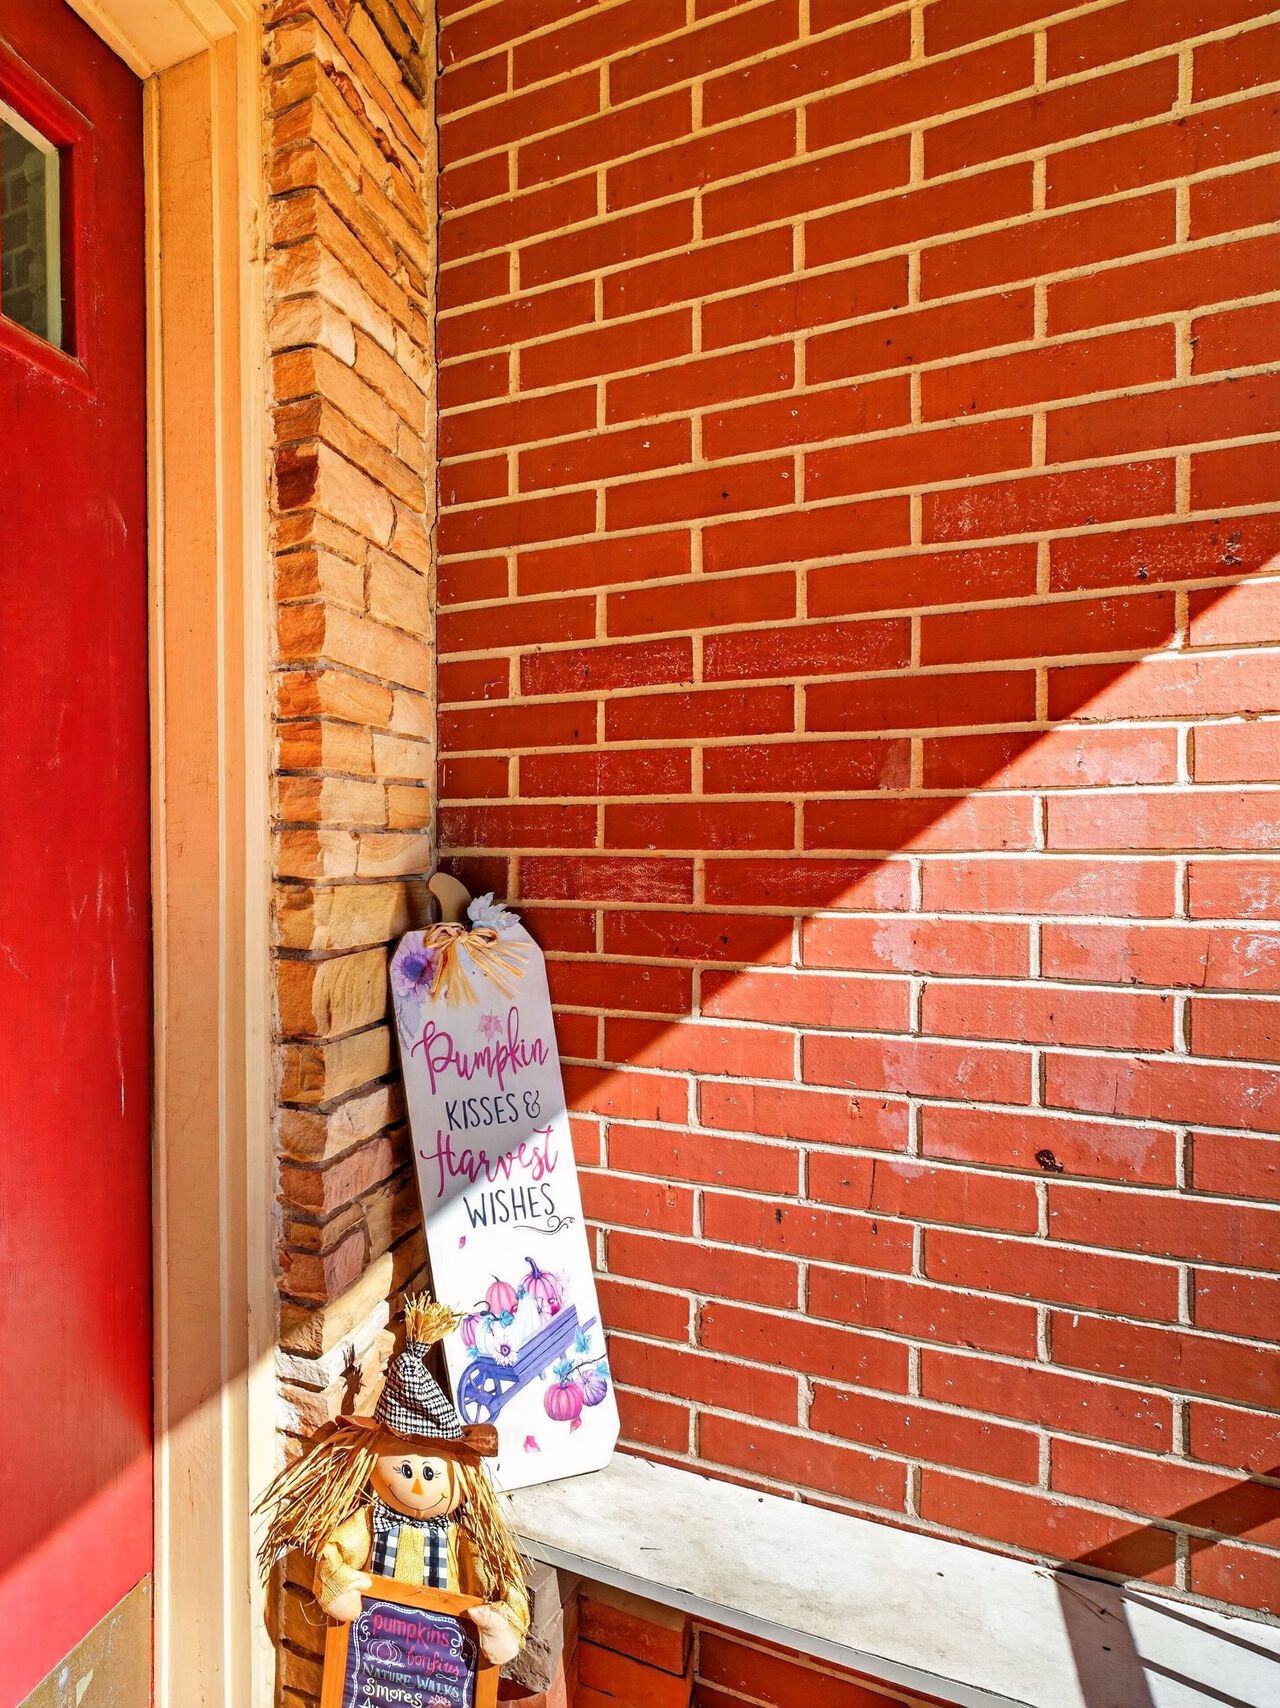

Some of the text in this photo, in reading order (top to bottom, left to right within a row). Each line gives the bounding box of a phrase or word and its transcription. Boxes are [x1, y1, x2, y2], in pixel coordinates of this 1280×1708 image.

[411, 1006, 549, 1095] Pumpkin
[445, 1090, 541, 1131] KISSES &
[420, 1124, 558, 1198] Harvest
[463, 1183, 555, 1229] WISHES
[372, 1614, 450, 1649] pumpkins
